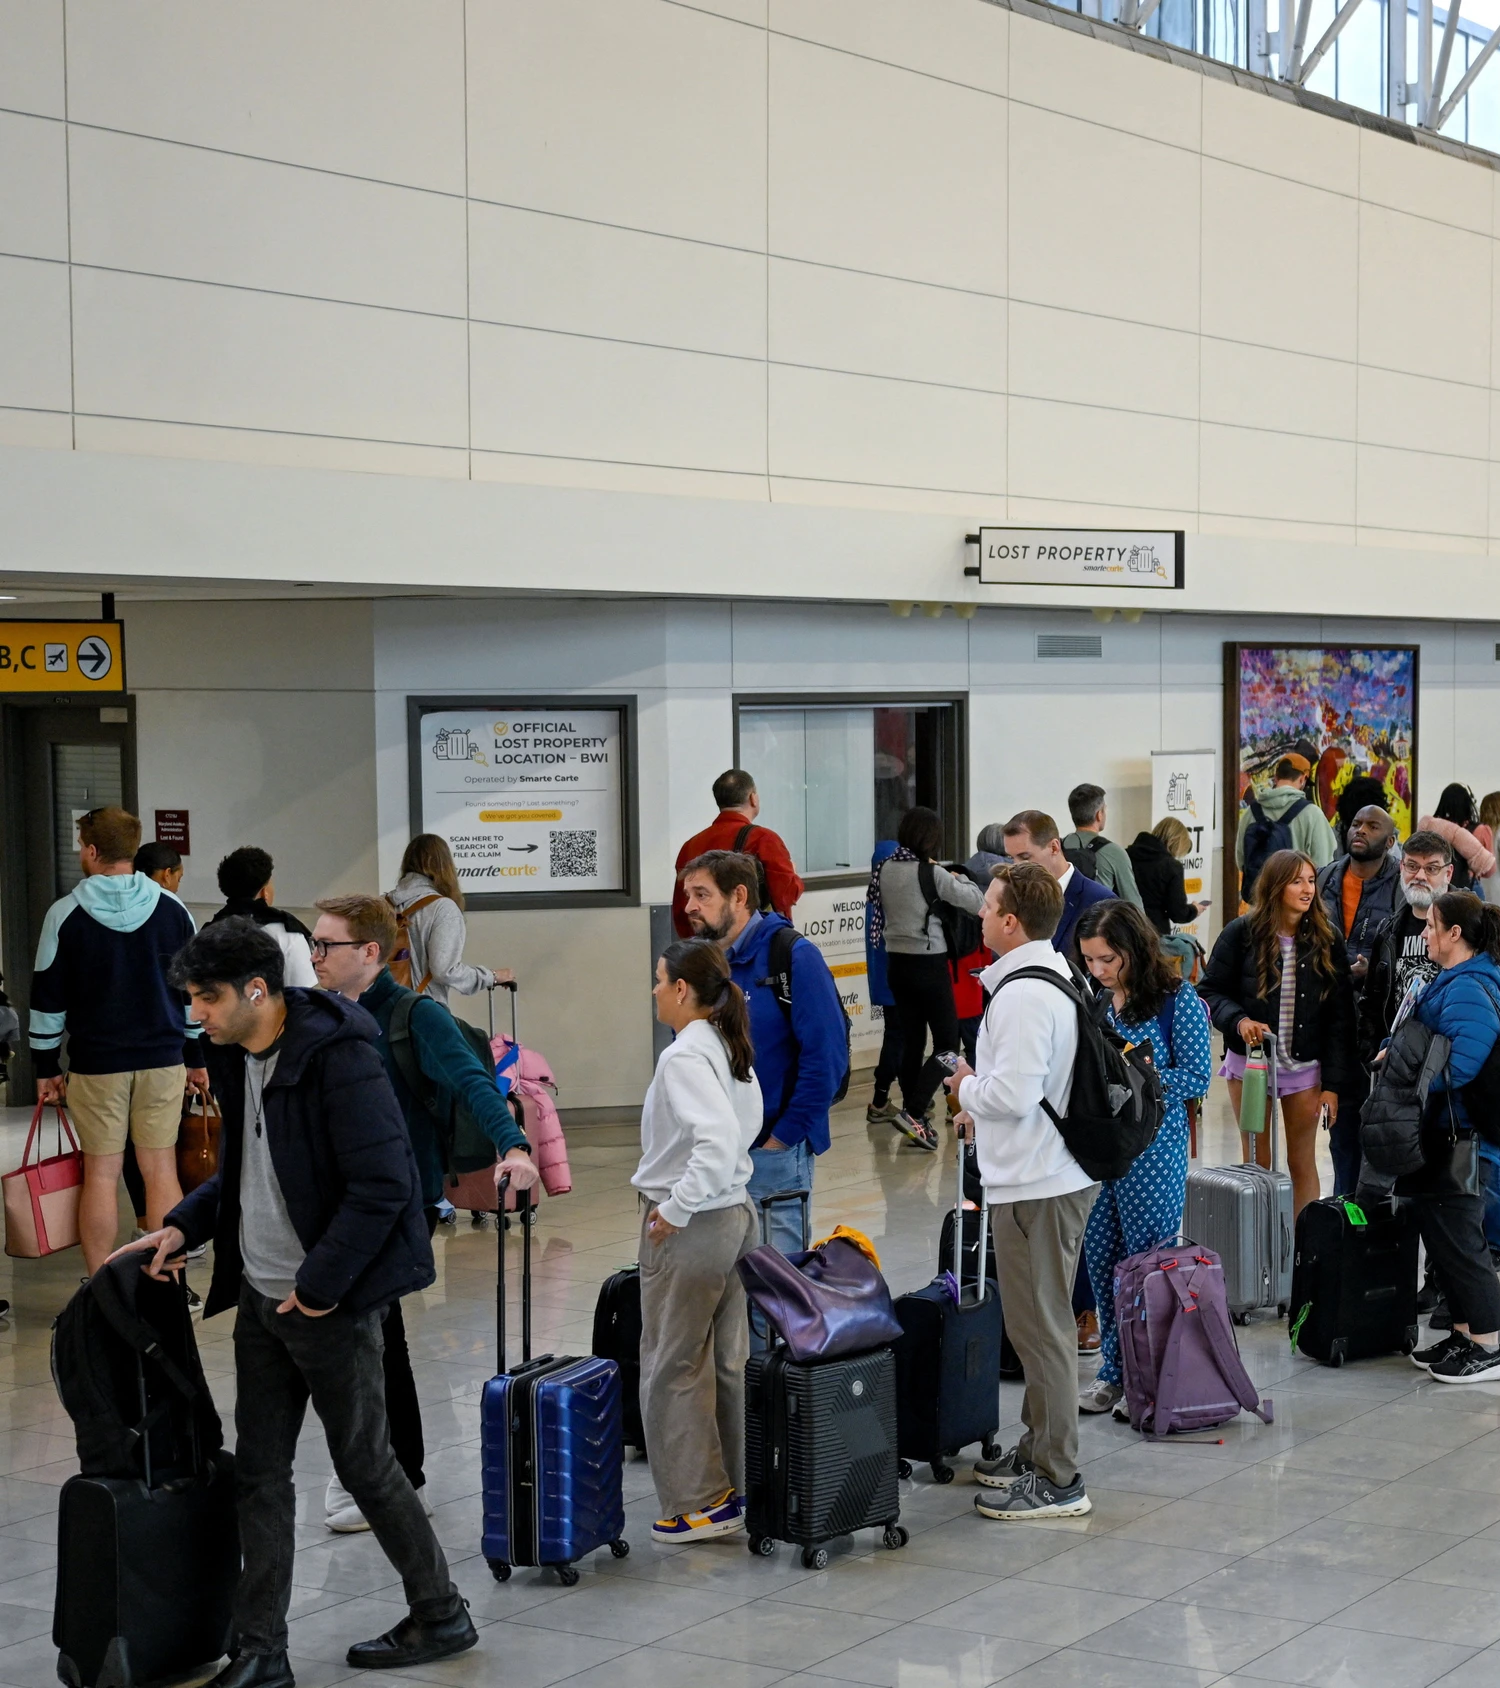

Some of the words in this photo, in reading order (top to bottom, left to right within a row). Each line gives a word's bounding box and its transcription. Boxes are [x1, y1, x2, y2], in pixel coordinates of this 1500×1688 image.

[988, 545, 1030, 559] LOST
[1037, 546, 1127, 561] PROPERTY
[1083, 564, 1124, 573] smartecarte
[512, 722, 576, 733] OFFICIAL
[494, 738, 529, 749] LOST
[533, 737, 608, 749] PROPERTY
[494, 753, 566, 764] LOCATION
[580, 753, 608, 764] BWI
[464, 775, 505, 784] Operated
[507, 775, 518, 784] by
[519, 775, 552, 783] Smarte
[541, 799, 579, 807] something?
[455, 864, 538, 878] martecarte
[833, 901, 867, 913] WELCOM
[804, 919, 834, 936] LOST
[841, 992, 859, 1005] arte
[846, 1003, 864, 1016] arte
